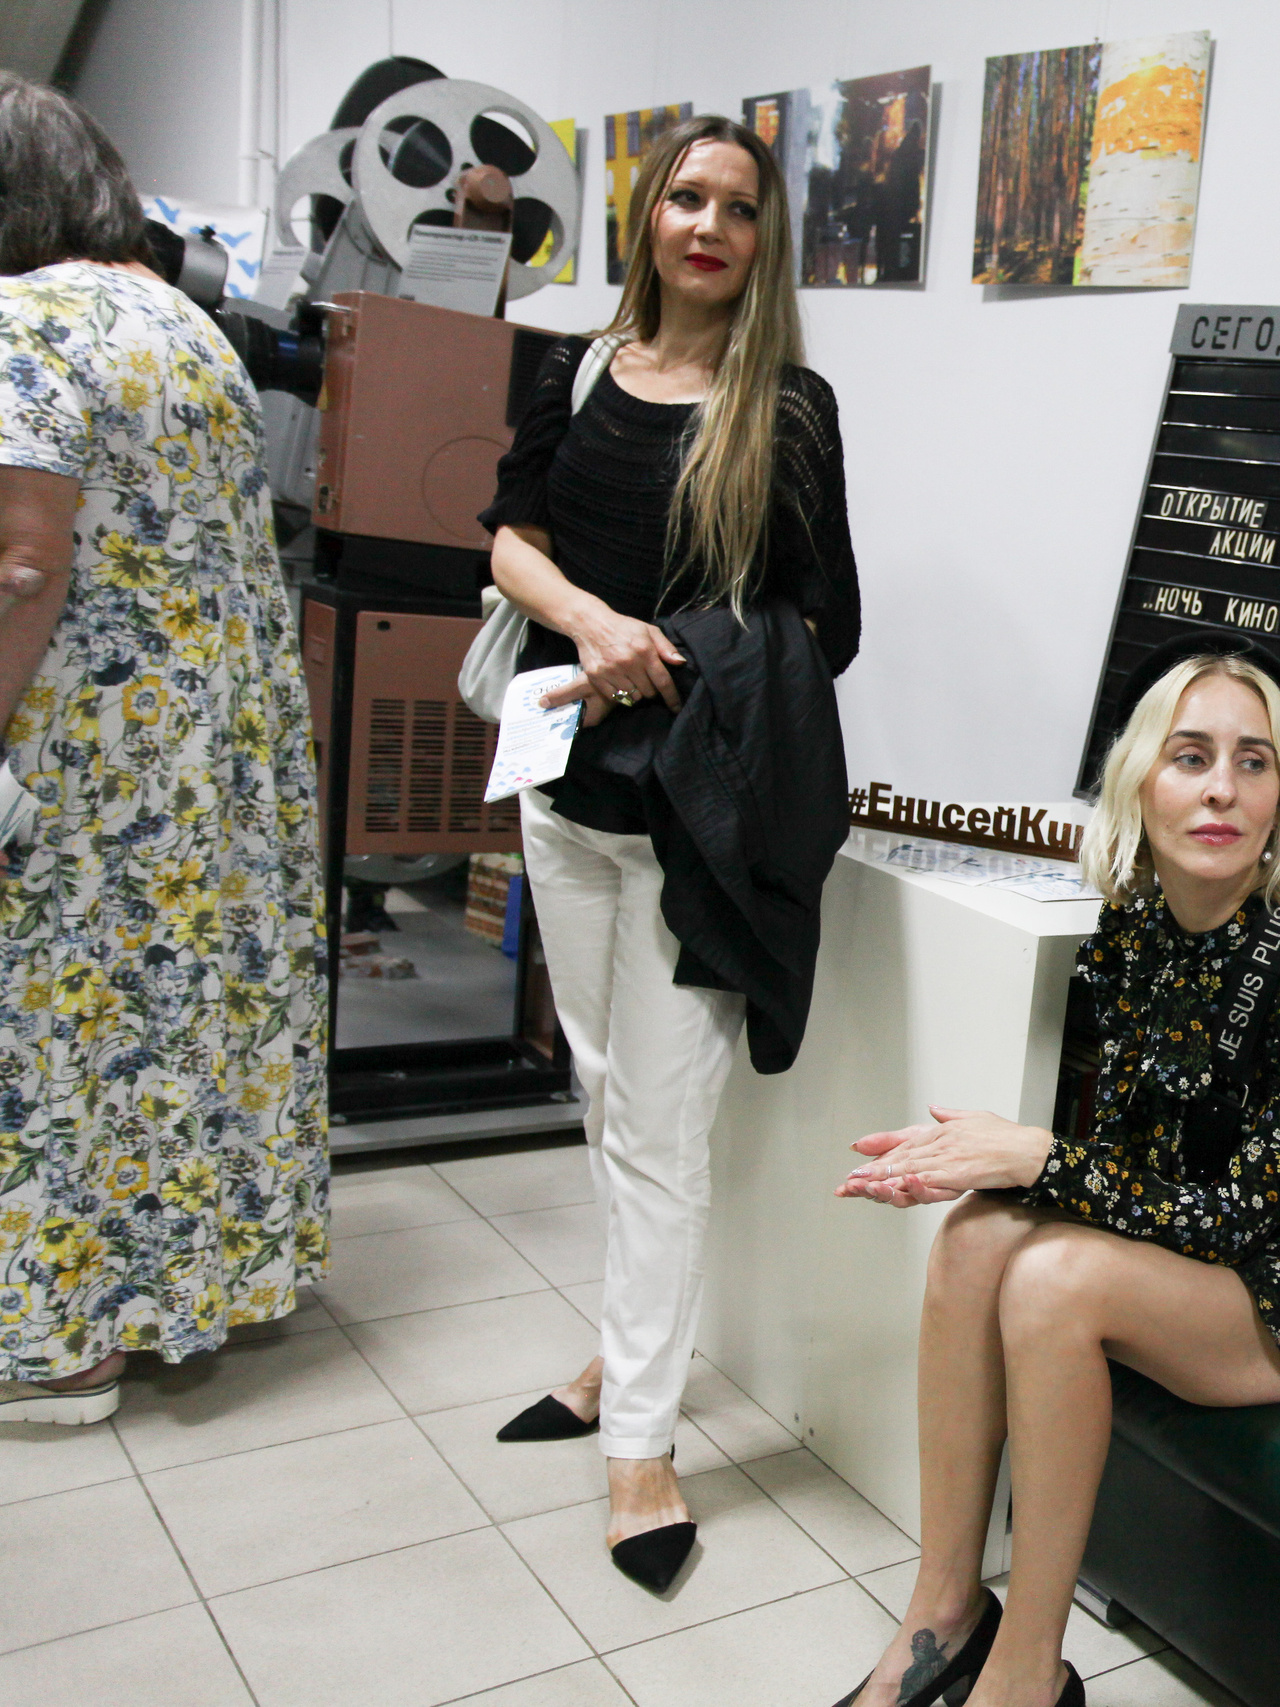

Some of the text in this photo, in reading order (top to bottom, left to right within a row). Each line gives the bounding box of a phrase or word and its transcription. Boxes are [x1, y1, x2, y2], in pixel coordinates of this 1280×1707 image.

[1160, 491, 1265, 528] ОТКРЫТИЕ
[1208, 530, 1276, 564] АКЦИИ
[1228, 973, 1264, 1028] SUIS
[1217, 1029, 1243, 1060] JE
